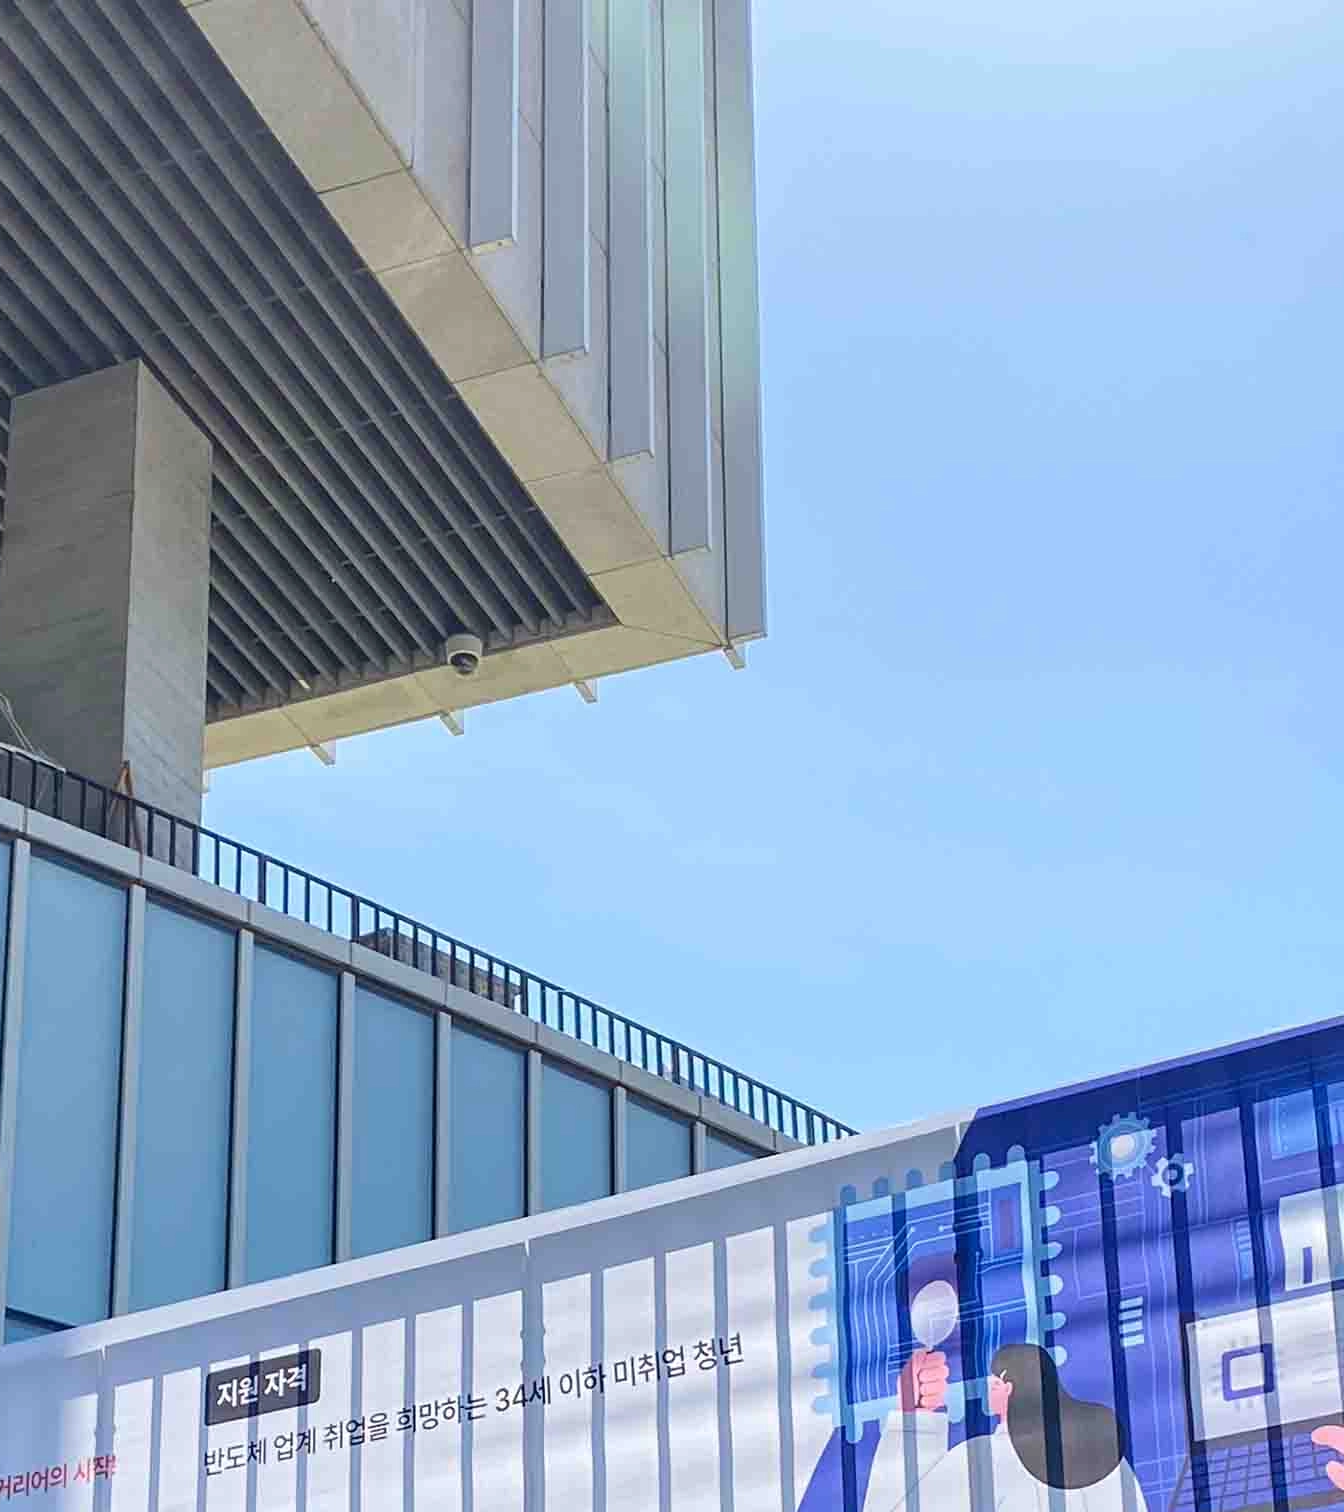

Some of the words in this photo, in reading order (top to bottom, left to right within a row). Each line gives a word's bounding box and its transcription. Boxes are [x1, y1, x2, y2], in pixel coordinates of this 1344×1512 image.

[204, 1437, 267, 1476] 반도체
[273, 1426, 317, 1463] 업계
[323, 1412, 390, 1451] 취업을
[396, 1391, 488, 1434] 희망하는
[495, 1375, 552, 1413] 34세
[559, 1362, 606, 1398] 이하
[613, 1345, 686, 1387] 미취업
[693, 1332, 745, 1371] 청년
[216, 1376, 259, 1407] 지원
[264, 1363, 308, 1397] 자격
